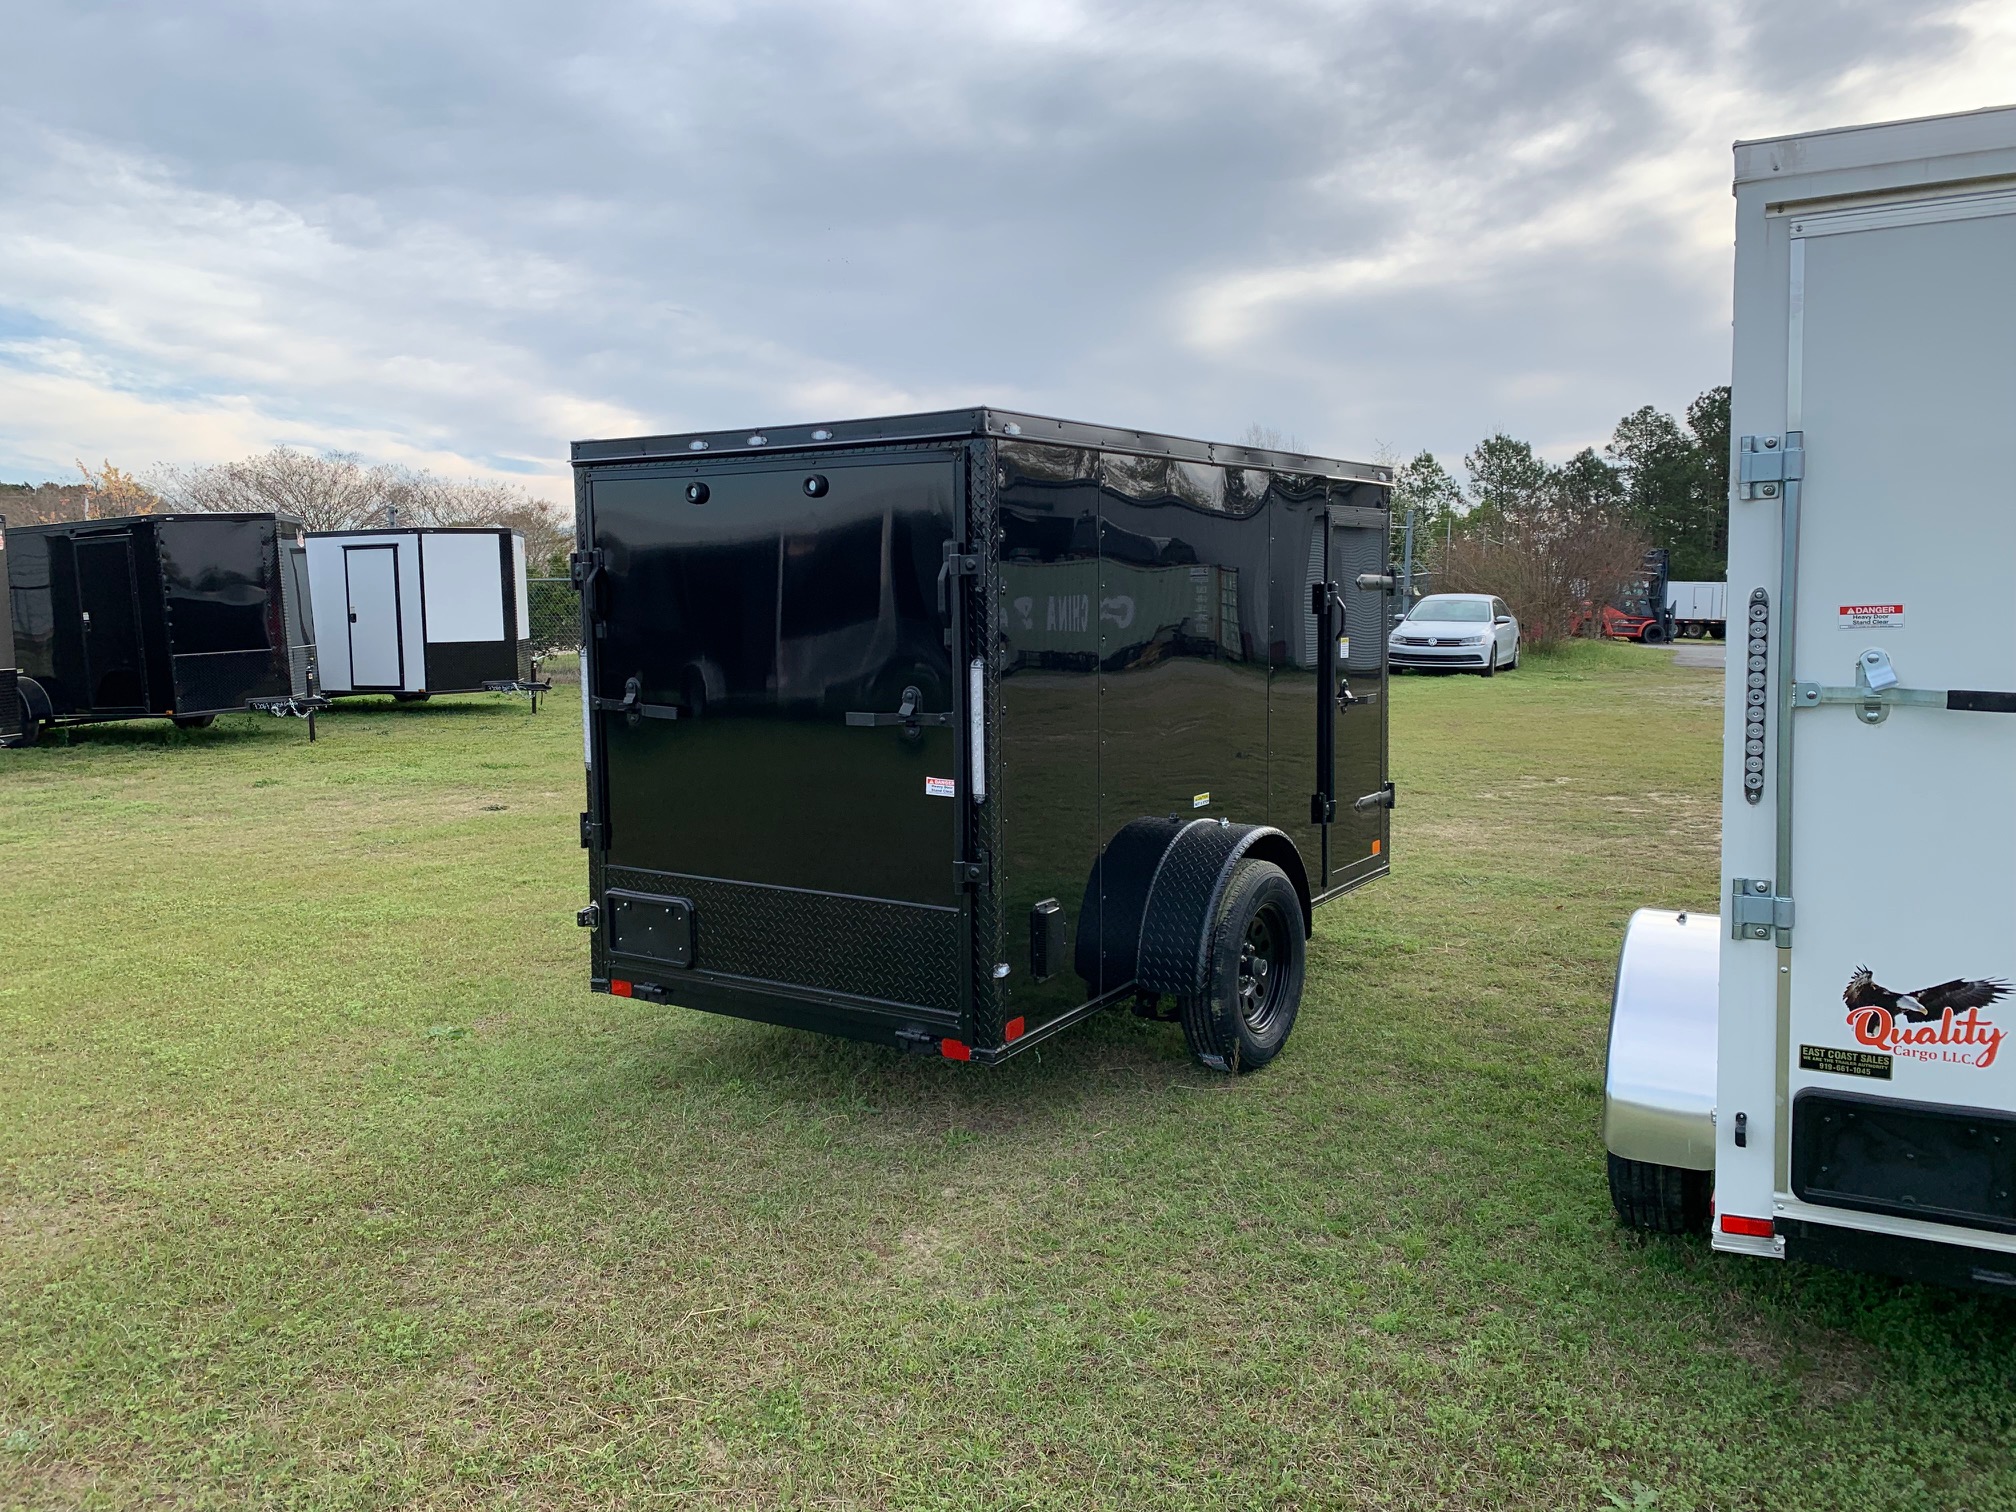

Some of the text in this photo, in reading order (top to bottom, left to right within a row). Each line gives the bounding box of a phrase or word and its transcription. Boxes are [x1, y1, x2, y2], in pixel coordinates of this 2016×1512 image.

[1855, 606, 1895, 614] DANGER
[1846, 1006, 2008, 1068] Quality
[1802, 1047, 1889, 1065] EAST COAST SALES
[1893, 1046, 1974, 1065] Cargo LLC.
[1819, 1063, 1871, 1075] 919-661-1045
